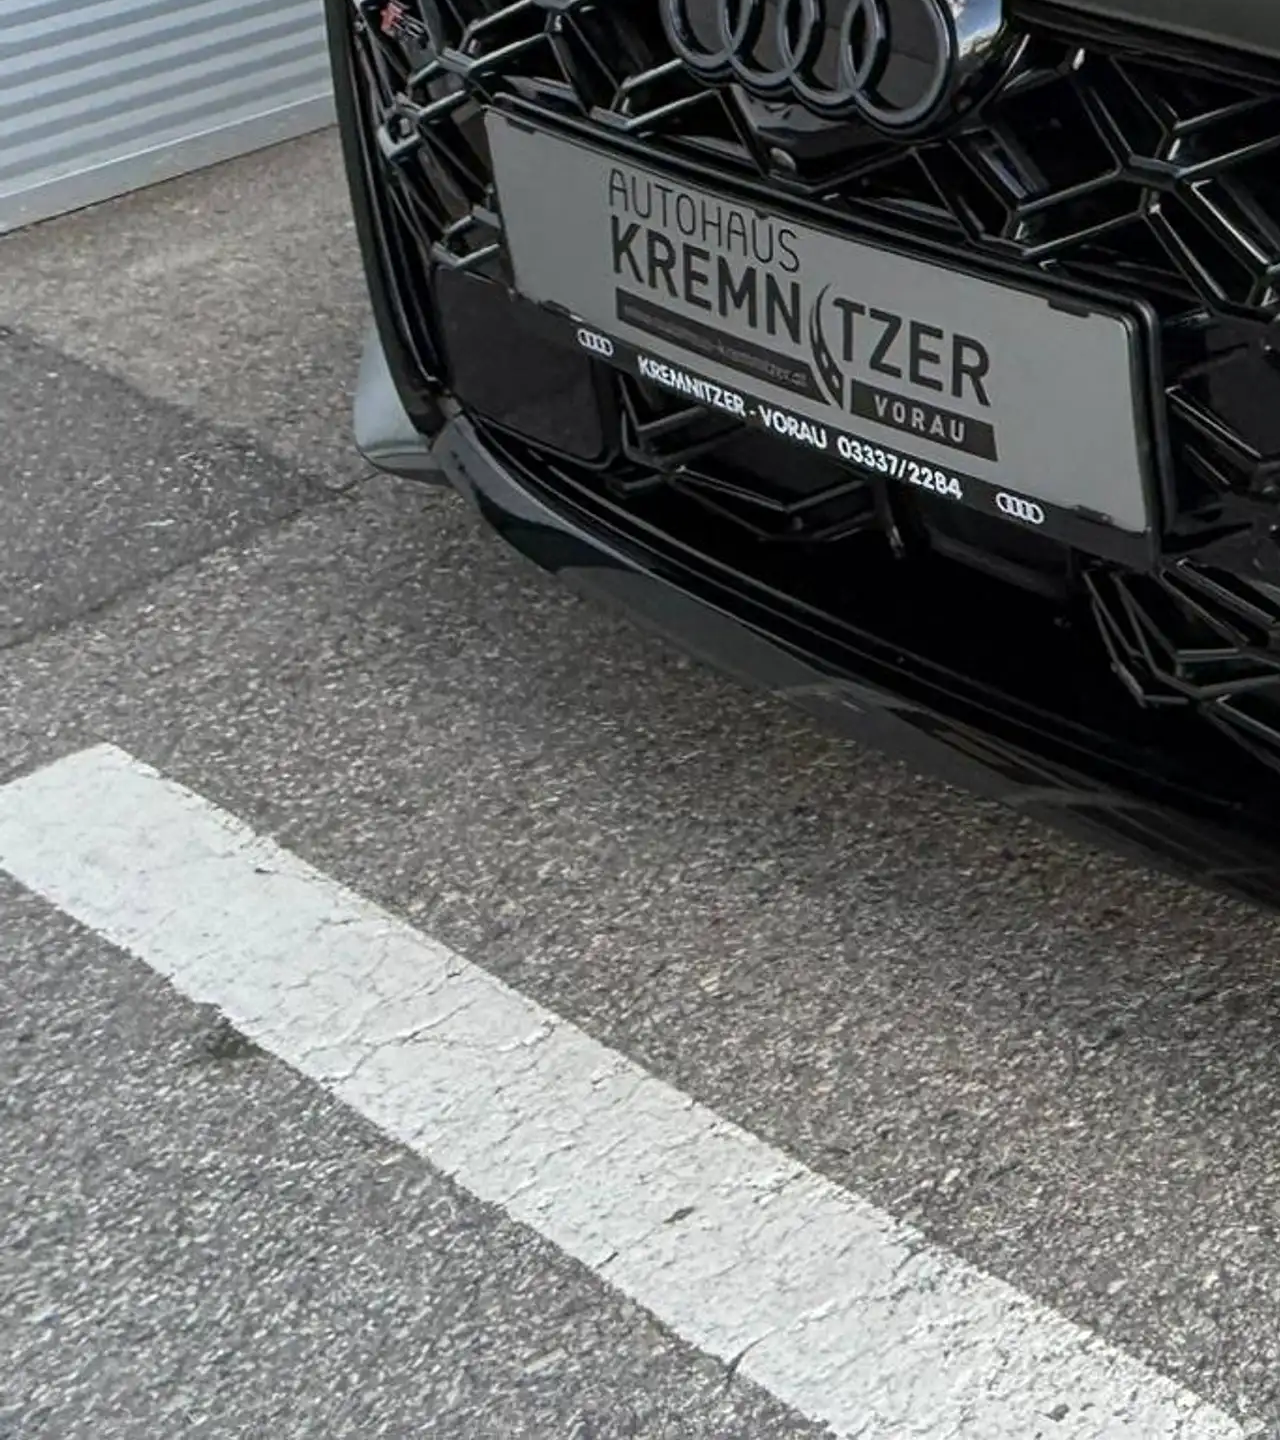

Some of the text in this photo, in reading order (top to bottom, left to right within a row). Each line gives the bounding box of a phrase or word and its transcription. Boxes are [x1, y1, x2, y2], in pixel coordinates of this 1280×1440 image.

[608, 167, 800, 273] AUTOHAUS
[637, 356, 746, 418] KREMNITZER
[758, 404, 828, 450] VORAU
[836, 435, 964, 501] 03337/2284
[873, 394, 966, 443] VORAU
